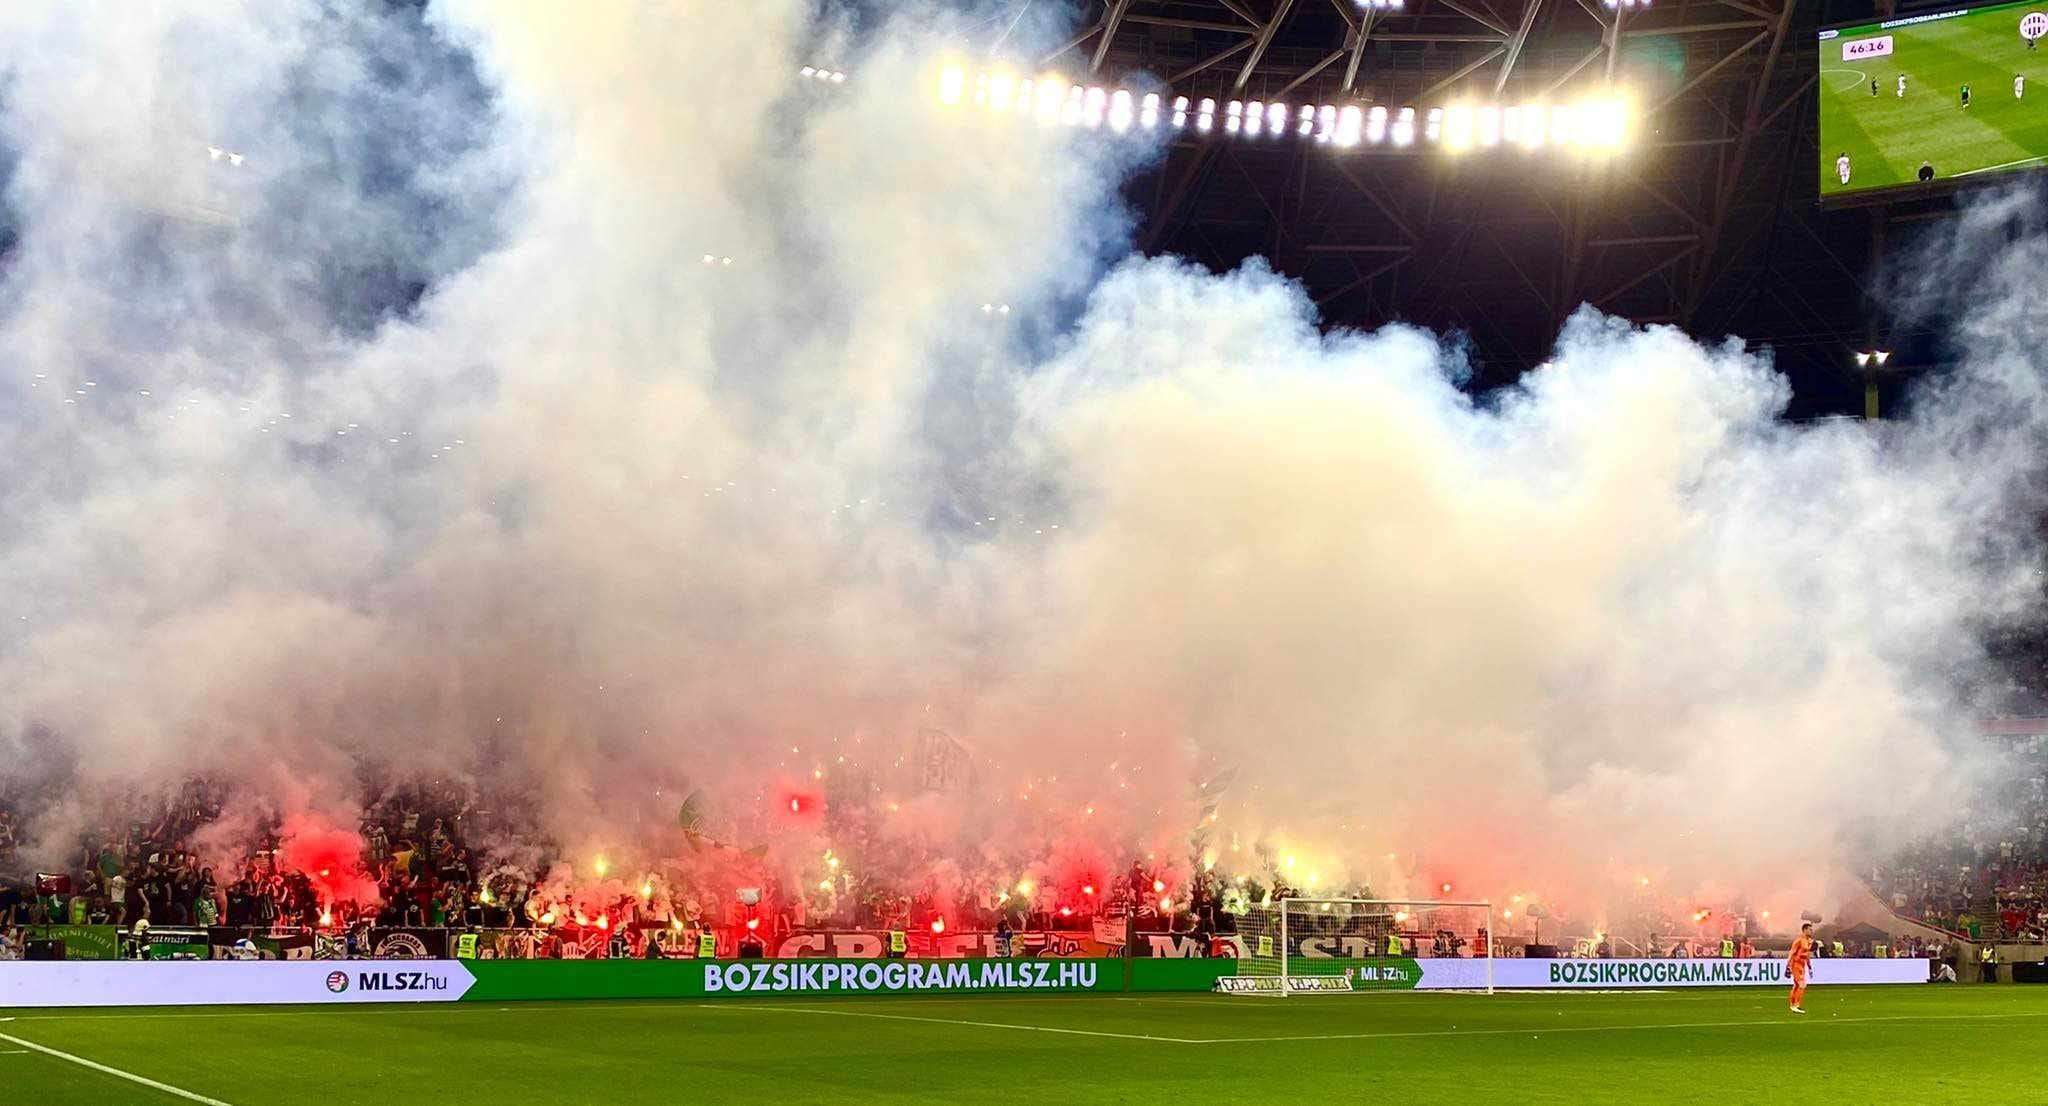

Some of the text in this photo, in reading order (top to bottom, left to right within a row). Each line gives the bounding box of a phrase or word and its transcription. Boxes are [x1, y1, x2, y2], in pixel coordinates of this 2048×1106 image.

[359, 972, 448, 991] MLSZ.hu
[704, 962, 1097, 992] BOZSIKPROGRAM.MLSZ.HU
[1549, 961, 1781, 984] BOZSIKPROGRAM.MLSZ.HU
